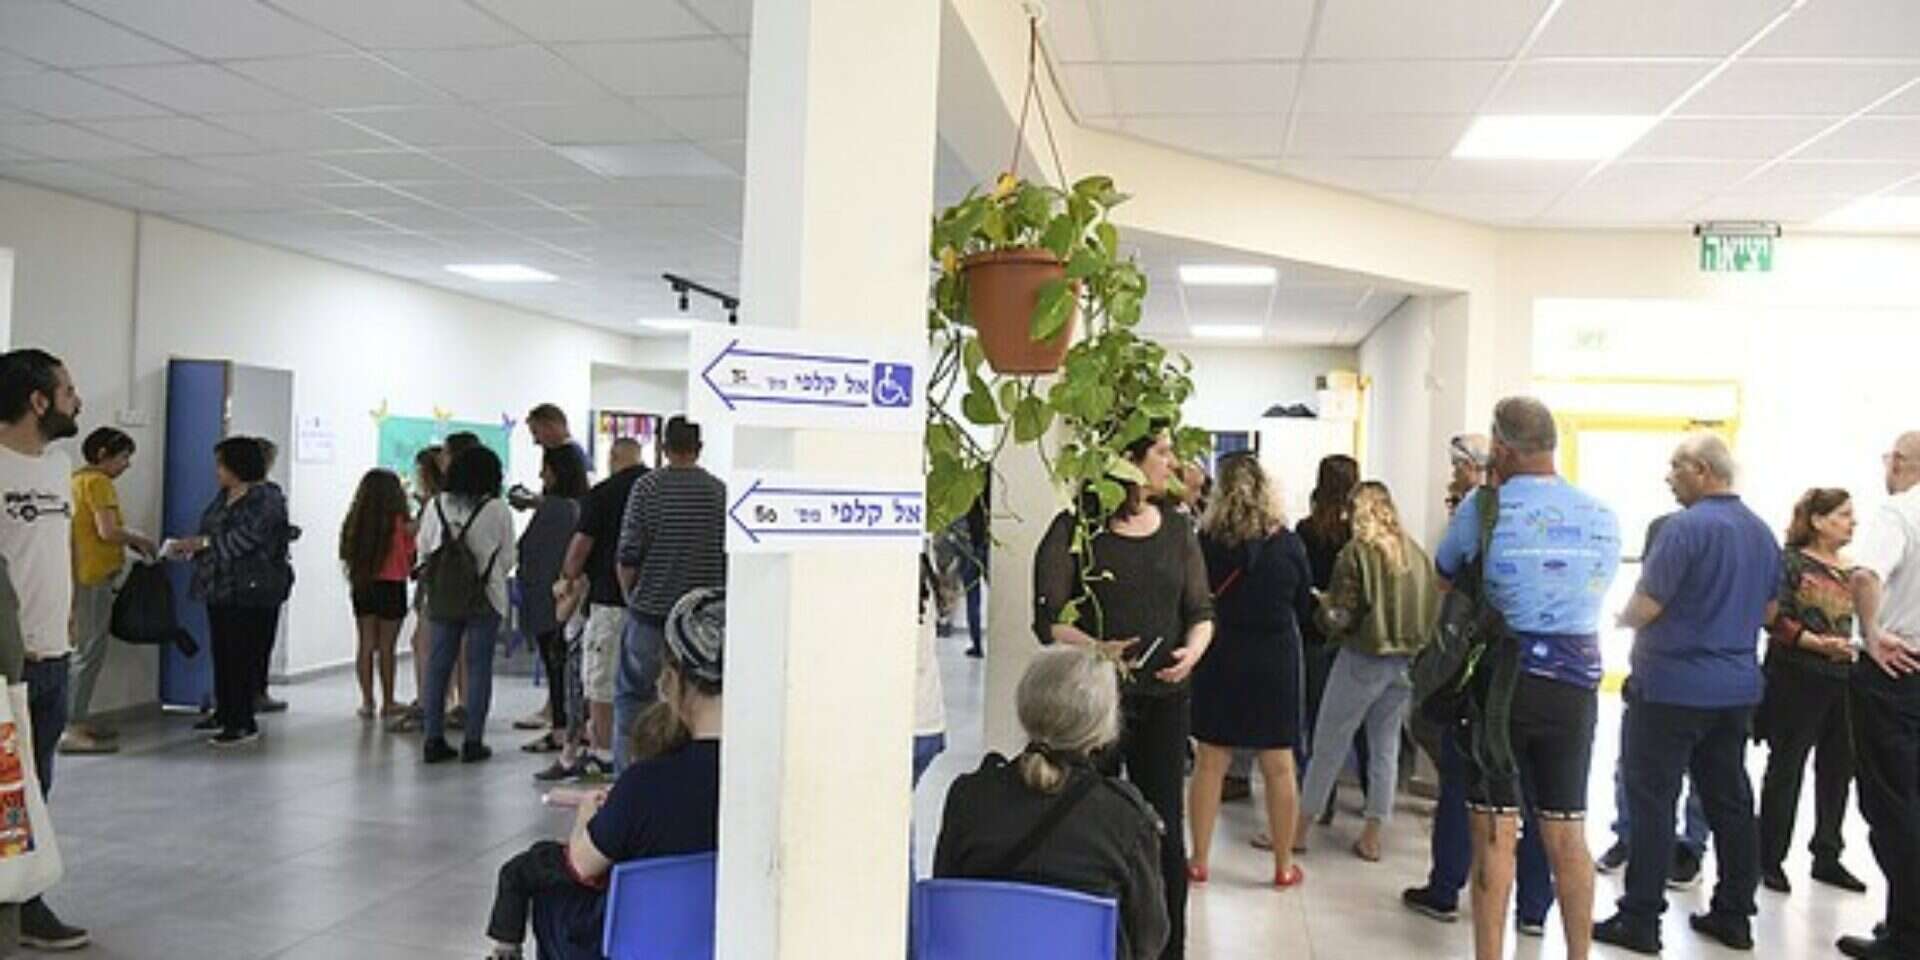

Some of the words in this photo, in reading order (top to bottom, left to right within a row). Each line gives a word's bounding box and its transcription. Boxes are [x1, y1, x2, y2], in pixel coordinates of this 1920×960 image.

[1703, 235, 1769, 271] יציאה
[794, 370, 837, 396] קלפי
[844, 373, 869, 394] אל
[830, 498, 882, 526] קלפי
[893, 498, 921, 523] אל
